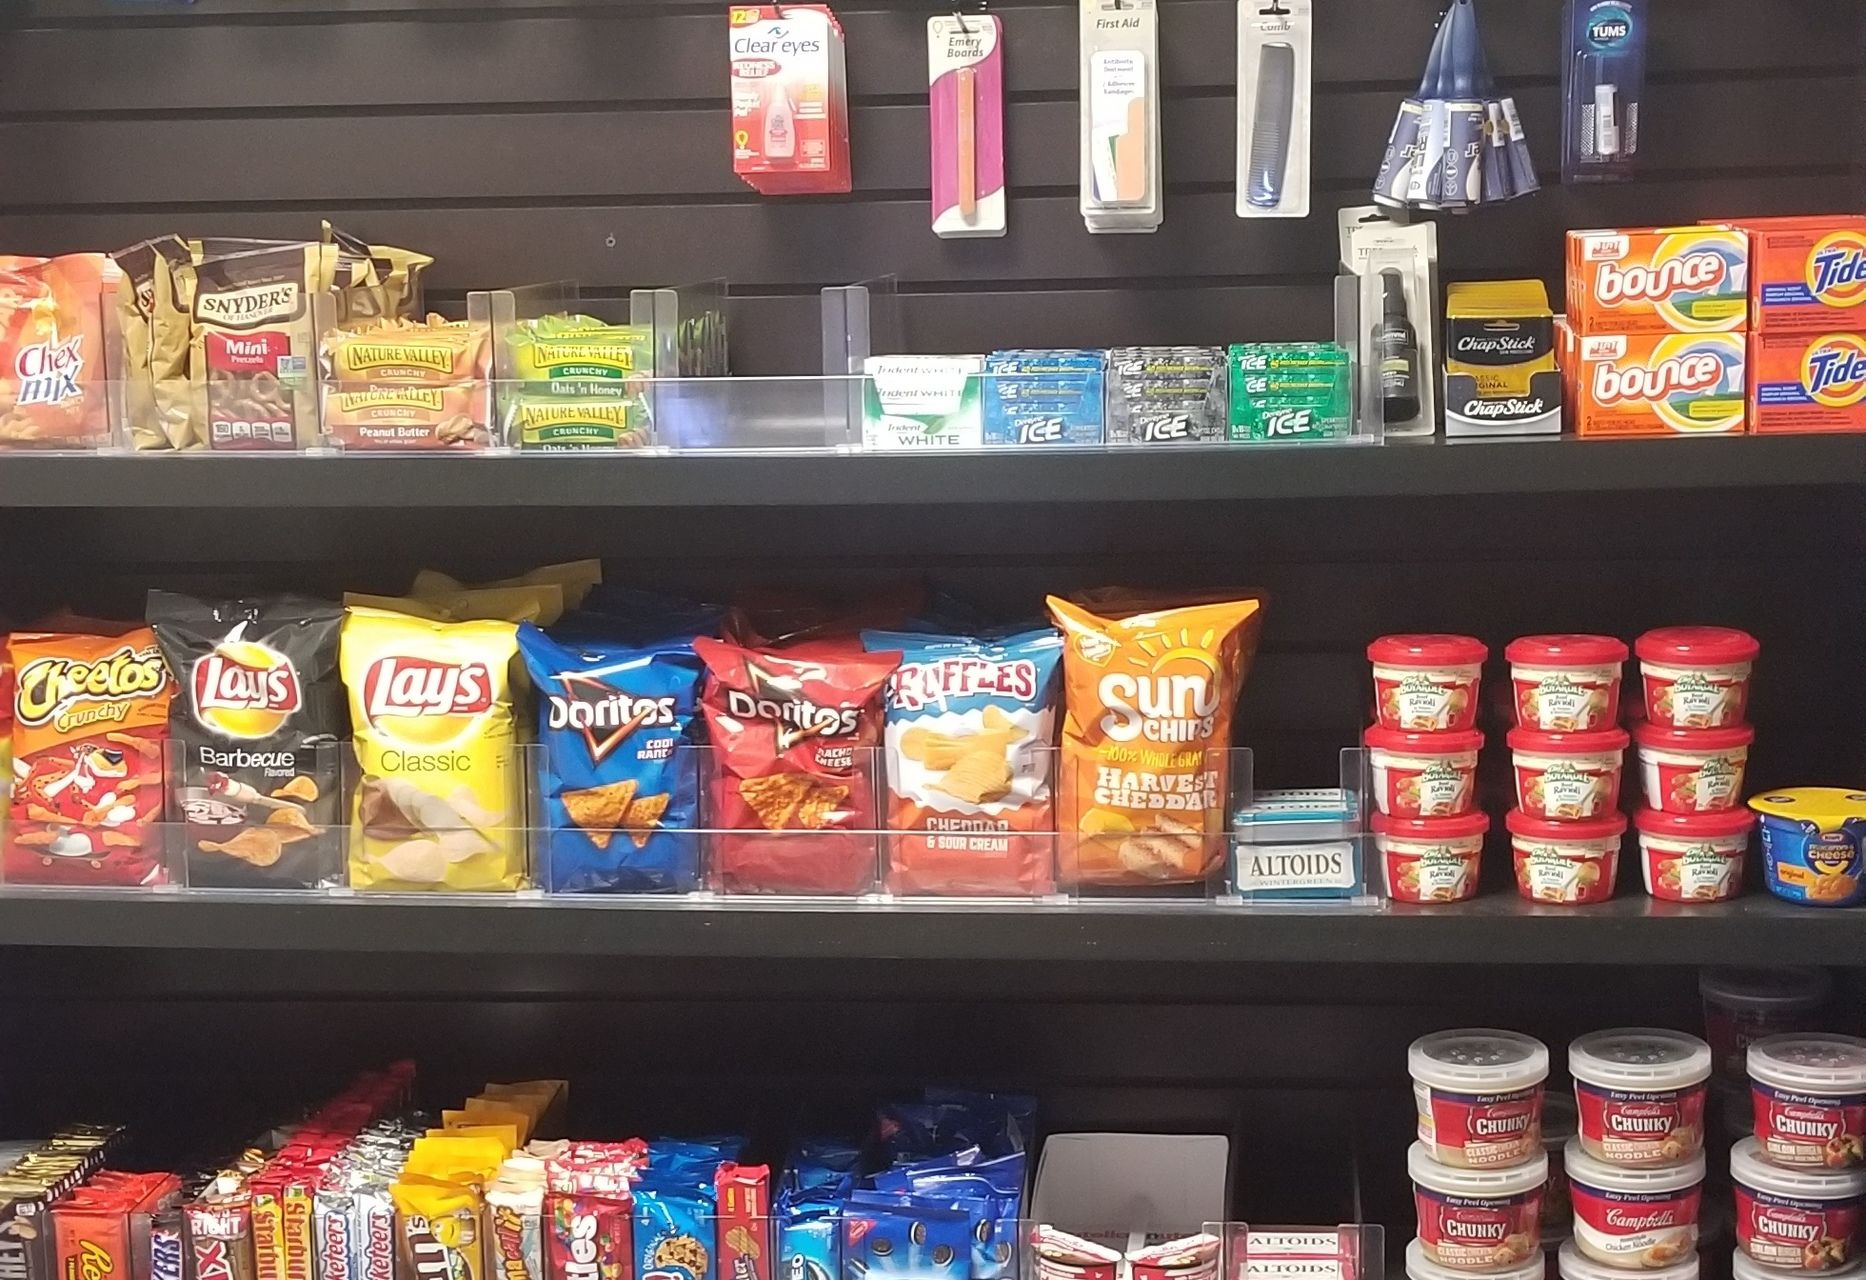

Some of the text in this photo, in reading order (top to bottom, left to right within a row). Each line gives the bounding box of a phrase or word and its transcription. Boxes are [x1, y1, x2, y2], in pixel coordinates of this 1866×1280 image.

[1096, 18, 1140, 29] First Aid
[1593, 25, 1627, 37] TUMS
[735, 37, 820, 57] Clear eyes
[947, 47, 984, 58] Boards
[948, 37, 983, 48] Emery
[1597, 254, 1721, 303] bounce
[1814, 250, 1866, 294] Tide
[203, 287, 293, 314] SNYDER'S
[225, 338, 268, 355] Mini
[1458, 336, 1535, 352] ChapStick
[19, 338, 79, 377] Chex
[352, 346, 448, 369] NATURE VALLEY
[537, 346, 631, 367] NATURE VALLEY
[380, 369, 426, 378] CRUNCHY
[563, 367, 608, 376] CRUNCHY
[1595, 355, 1718, 403] bounce
[1809, 351, 1866, 394] Tide
[20, 365, 79, 402] mix
[551, 382, 575, 394] Oats
[589, 383, 622, 397] Honey
[344, 389, 437, 407] NATURE VALLEY
[1464, 398, 1543, 418] ChapStick
[371, 409, 416, 418] CRUNCHY
[525, 406, 622, 426] NATURE VALLEY
[1267, 409, 1312, 437] ICE
[360, 427, 430, 437] Peanut Butter
[553, 427, 599, 436] CRUNCHY
[1020, 416, 1065, 444] ICE
[1145, 414, 1190, 441] ICE
[898, 435, 960, 446] WHITE
[20, 650, 163, 719] Cheetos
[201, 657, 291, 709] Lay's
[369, 658, 486, 717] Lay's
[894, 660, 1036, 708] RUFFLES
[56, 701, 130, 731] Crunchy
[549, 695, 675, 730] Doritos
[728, 690, 860, 736] Doritos
[1099, 673, 1221, 743] Sun
[1143, 716, 1214, 743] CHIPS
[200, 746, 295, 768] Barbecue
[381, 750, 471, 772] Classic
[1105, 748, 1177, 768] 100% WHOLE
[1096, 768, 1218, 793] HARVEST
[1094, 788, 1217, 810] CHEDDAR
[937, 835, 967, 850] SOUR
[969, 837, 1009, 852] CREAM
[1250, 853, 1342, 877] ALTOIDS
[1476, 1114, 1531, 1135] CHUNKY
[1611, 1114, 1673, 1133] CHUNKY
[1776, 1114, 1838, 1140] CHUNKY
[1468, 1148, 1520, 1164] NOODLE
[1605, 1150, 1662, 1159] NOODLE
[191, 1216, 241, 1235] RIGHT
[1447, 1219, 1506, 1240] CHUNKY
[1606, 1208, 1674, 1231] Campbell's
[1758, 1215, 1819, 1242] CHUNKY
[1249, 1237, 1337, 1246] ALTOIDS
[1247, 1265, 1337, 1273] ALTOIDS
[1440, 1256, 1494, 1265] NOODLE
